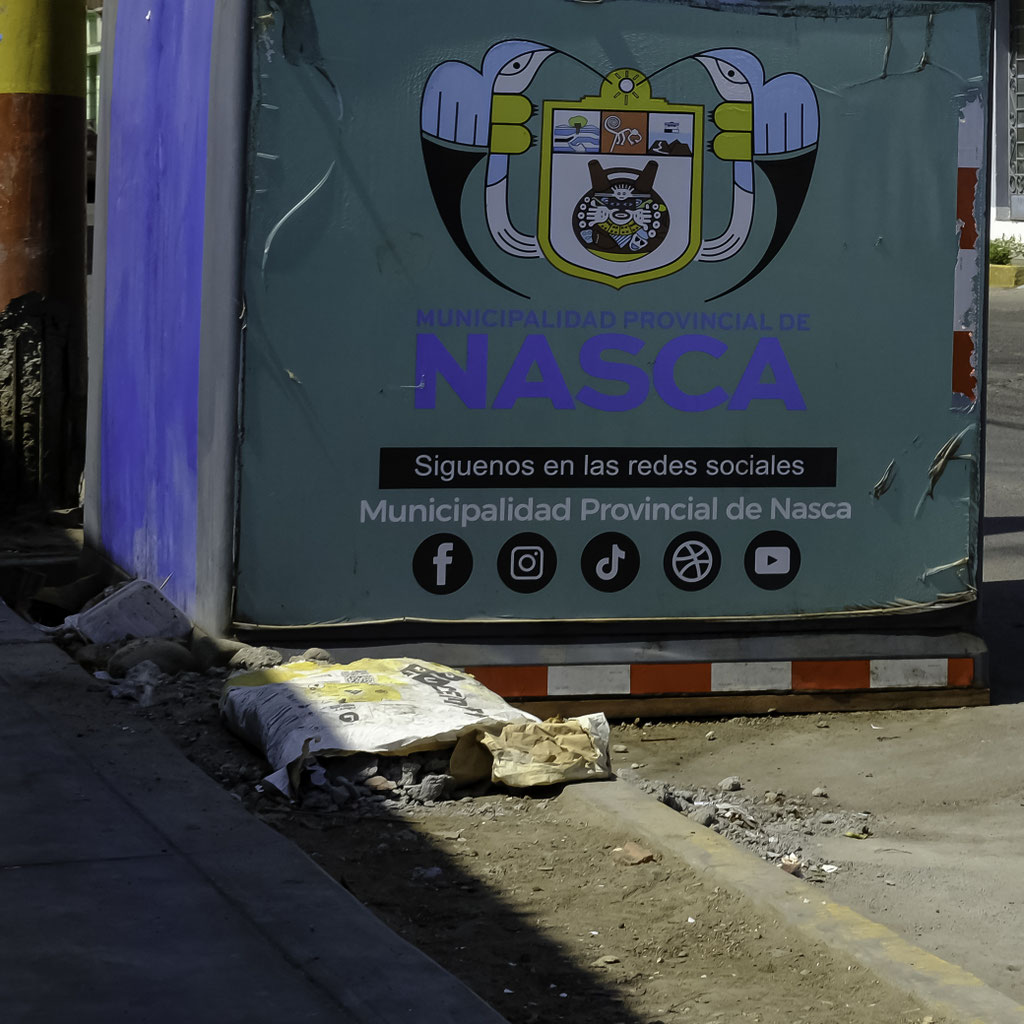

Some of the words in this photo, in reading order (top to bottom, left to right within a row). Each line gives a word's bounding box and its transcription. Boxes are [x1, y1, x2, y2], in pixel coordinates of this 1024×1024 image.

[416, 309, 616, 330] MUNICIPALIDAD
[623, 311, 772, 331] PROVINCIAL
[780, 313, 810, 331] DE
[414, 333, 808, 412] NASCA
[415, 455, 535, 482] Siguenos
[544, 460, 574, 476] en
[584, 455, 619, 476] las
[628, 455, 697, 476] redes
[706, 455, 805, 476] sociales
[360, 497, 571, 527] Municipalidad
[581, 497, 717, 521] Provincial
[726, 497, 762, 520] de
[771, 498, 852, 520] Nasca
